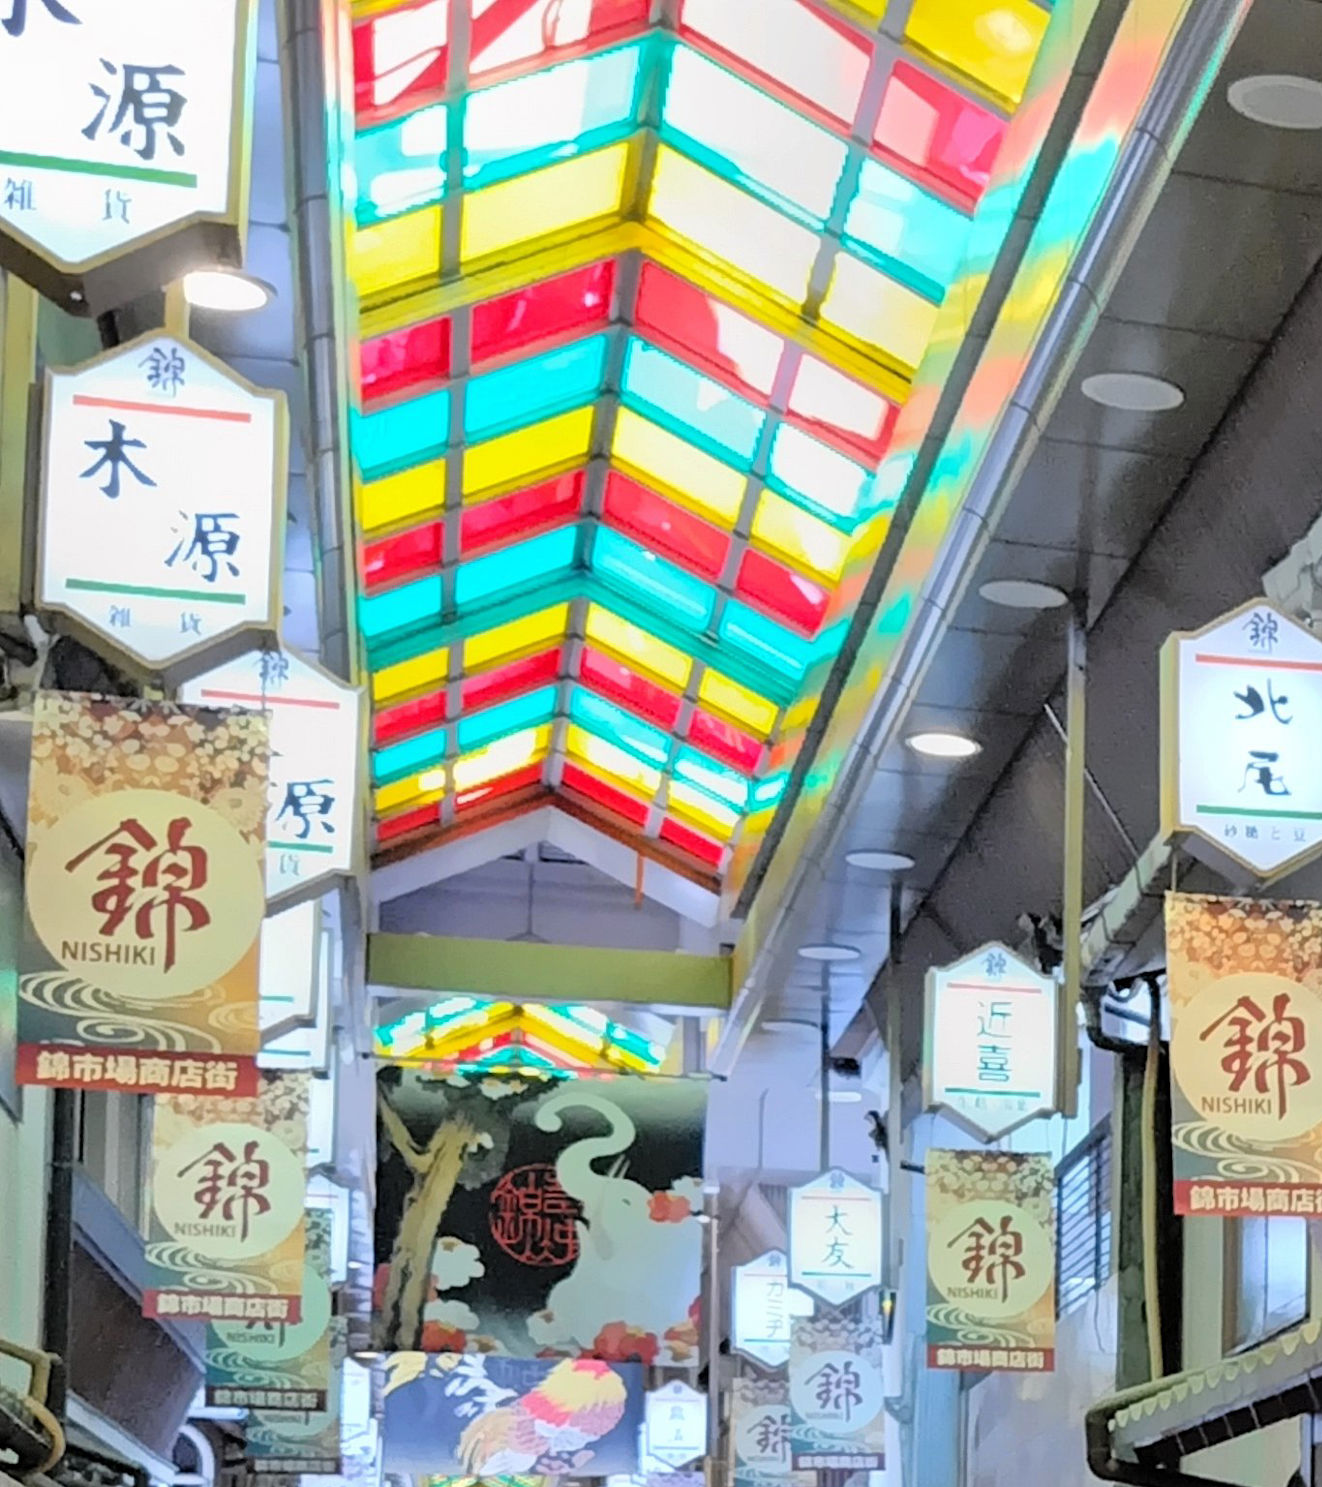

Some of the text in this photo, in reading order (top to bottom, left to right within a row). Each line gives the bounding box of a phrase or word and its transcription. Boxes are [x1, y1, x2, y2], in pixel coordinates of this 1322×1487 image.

[138, 347, 186, 396] 錦
[79, 420, 241, 582] 木源
[1233, 678, 1294, 796] 北尾
[64, 816, 211, 974] 錦
[61, 940, 156, 967] NISHIKI
[36, 1050, 238, 1091] 錦市場商店街
[1200, 993, 1311, 1120] 錦
[1202, 1096, 1272, 1115] NISHIKI
[177, 1140, 271, 1242] 錦
[174, 1222, 236, 1239] NISHIKI
[821, 1205, 855, 1270] 大友
[947, 1214, 1026, 1304] 錦
[947, 1285, 998, 1300] NISHIKI
[804, 1361, 863, 1423] 錦
